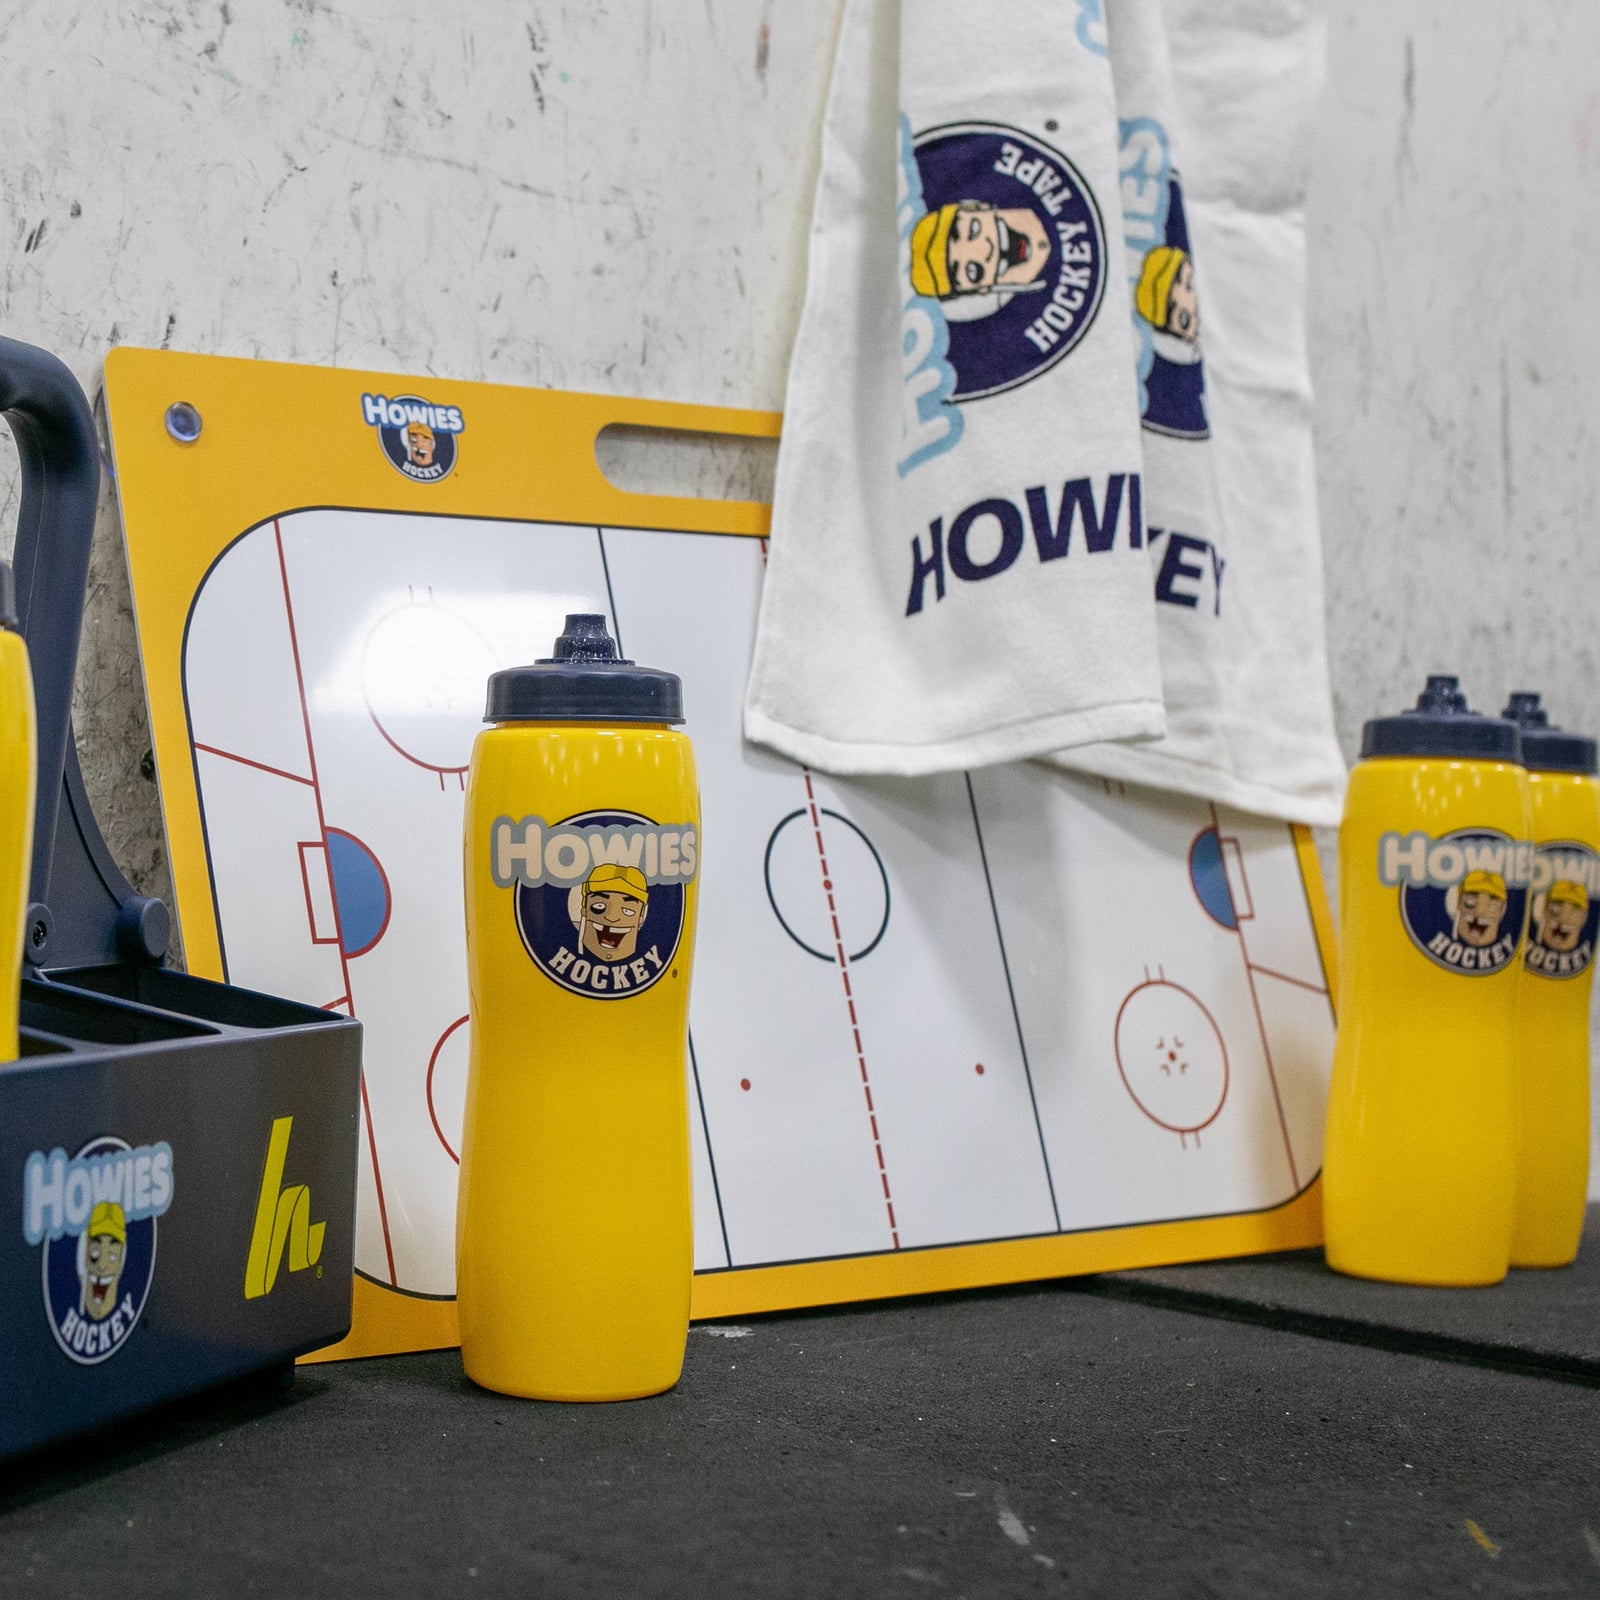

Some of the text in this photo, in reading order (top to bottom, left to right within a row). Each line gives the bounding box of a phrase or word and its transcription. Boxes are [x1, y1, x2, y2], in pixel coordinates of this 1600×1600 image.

[993, 142, 1092, 352] HOCKEY TAPE
[362, 394, 464, 433] HOWIES
[402, 461, 444, 479] HOCKEY
[494, 820, 696, 884] HOWIES
[548, 945, 663, 990] HOCKEY
[1427, 932, 1515, 969] HOCKEY
[26, 1147, 172, 1238] HOWIES
[60, 1292, 136, 1355] HOCKEY
